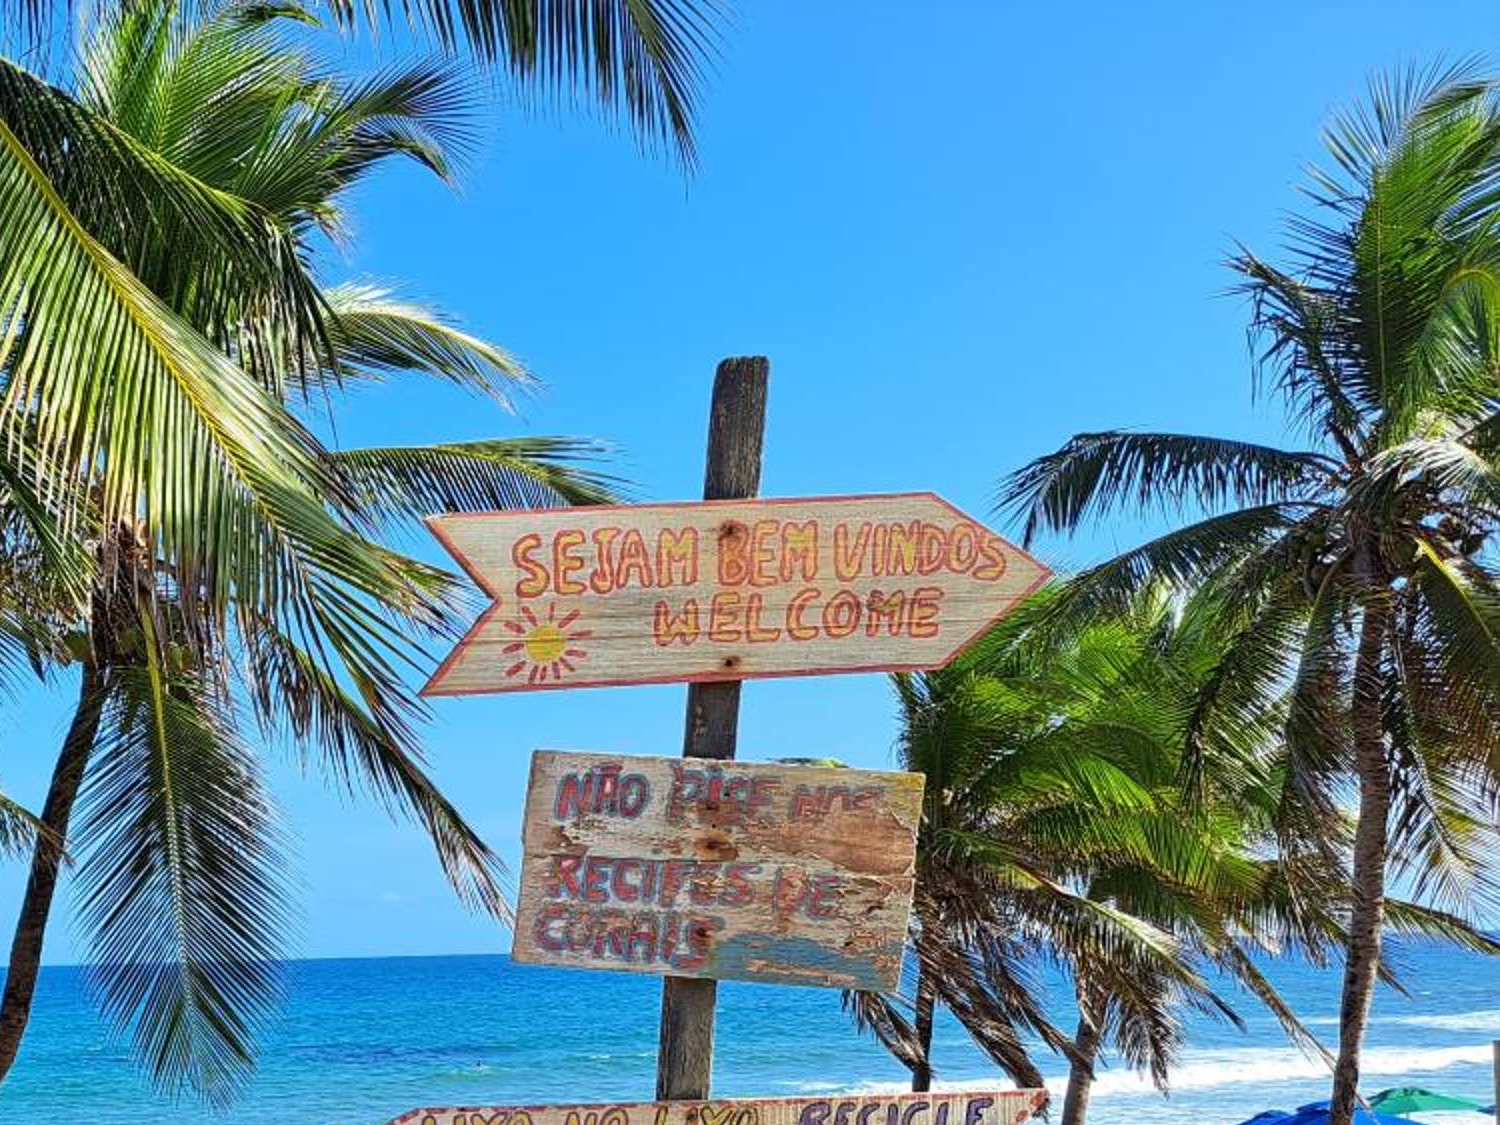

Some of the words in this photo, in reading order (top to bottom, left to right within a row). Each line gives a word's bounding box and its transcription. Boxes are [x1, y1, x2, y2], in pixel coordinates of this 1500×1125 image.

[512, 525, 700, 598] SEJAM
[717, 519, 818, 587] BEM
[834, 519, 1007, 581] VINDOS
[653, 587, 945, 647] WELCOME
